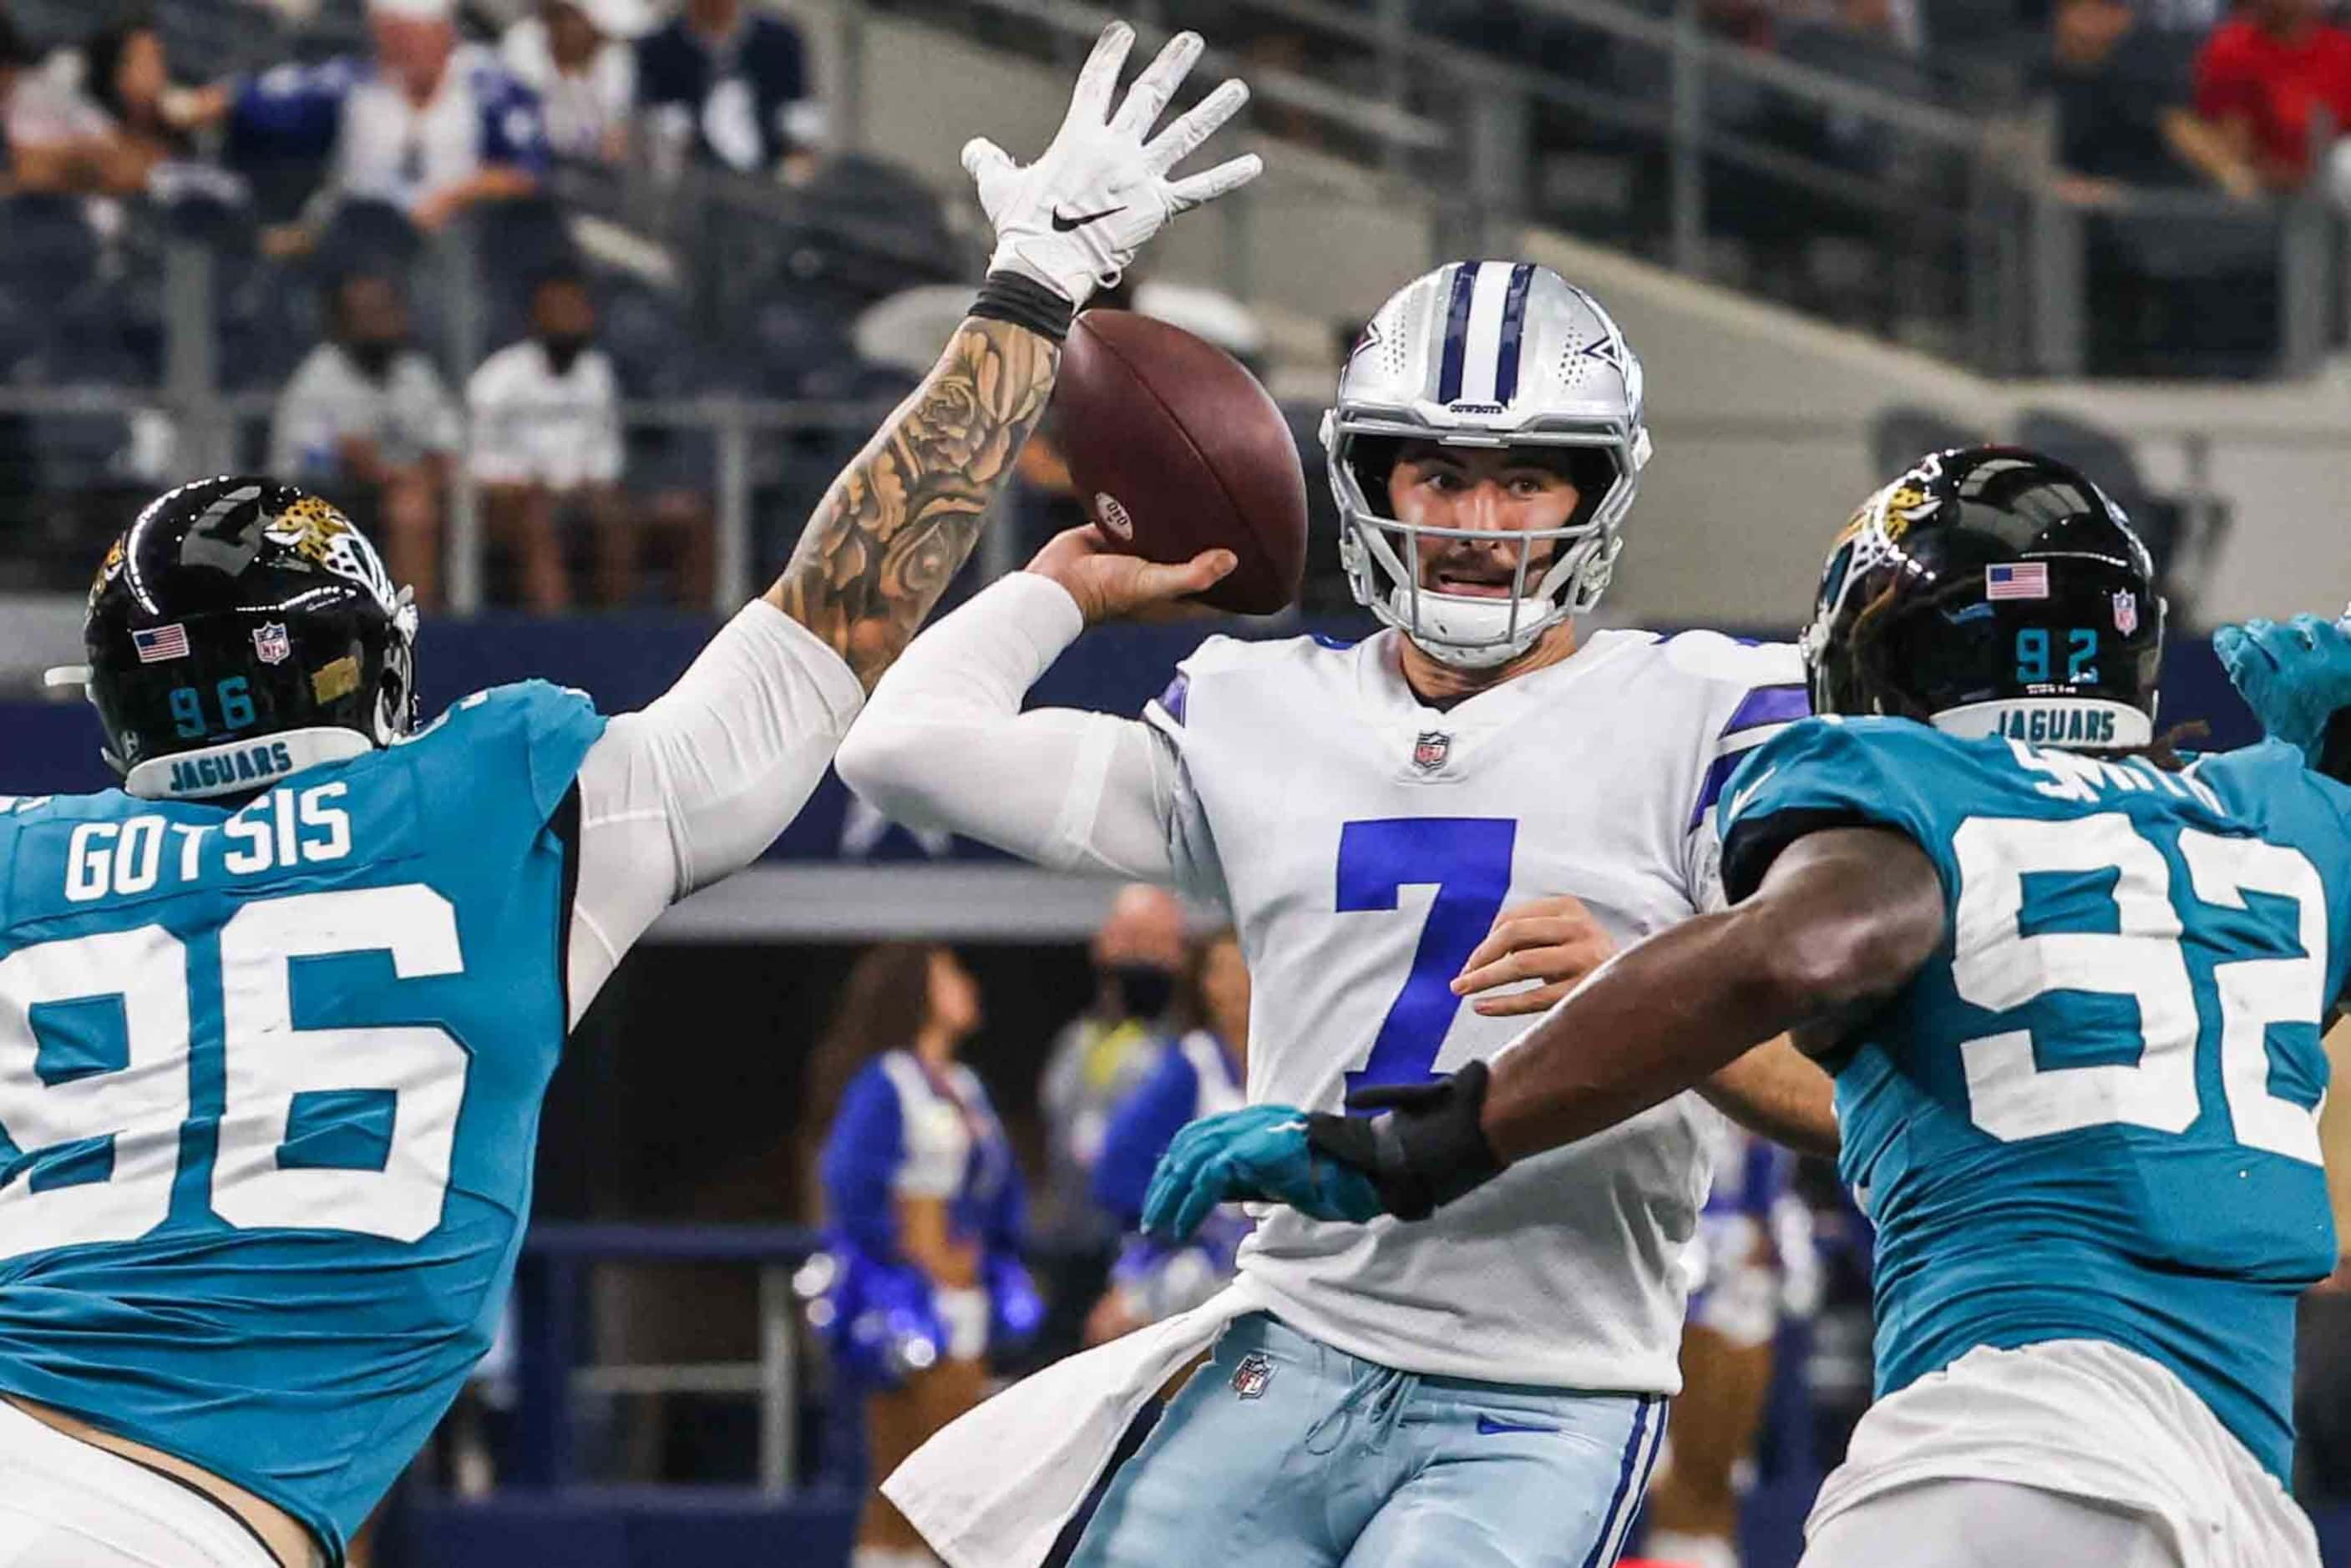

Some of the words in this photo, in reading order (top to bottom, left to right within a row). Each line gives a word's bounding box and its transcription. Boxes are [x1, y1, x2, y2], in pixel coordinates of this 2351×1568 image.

[2015, 628, 2099, 684] 92
[169, 675, 256, 739] 96
[1997, 709, 2116, 742] JAGUARS
[170, 741, 294, 792] JAGUARS
[64, 781, 352, 903] GOTSIS
[1335, 817, 1517, 1117] 7
[1951, 812, 2328, 1167] 92
[0, 883, 471, 1258] 96
